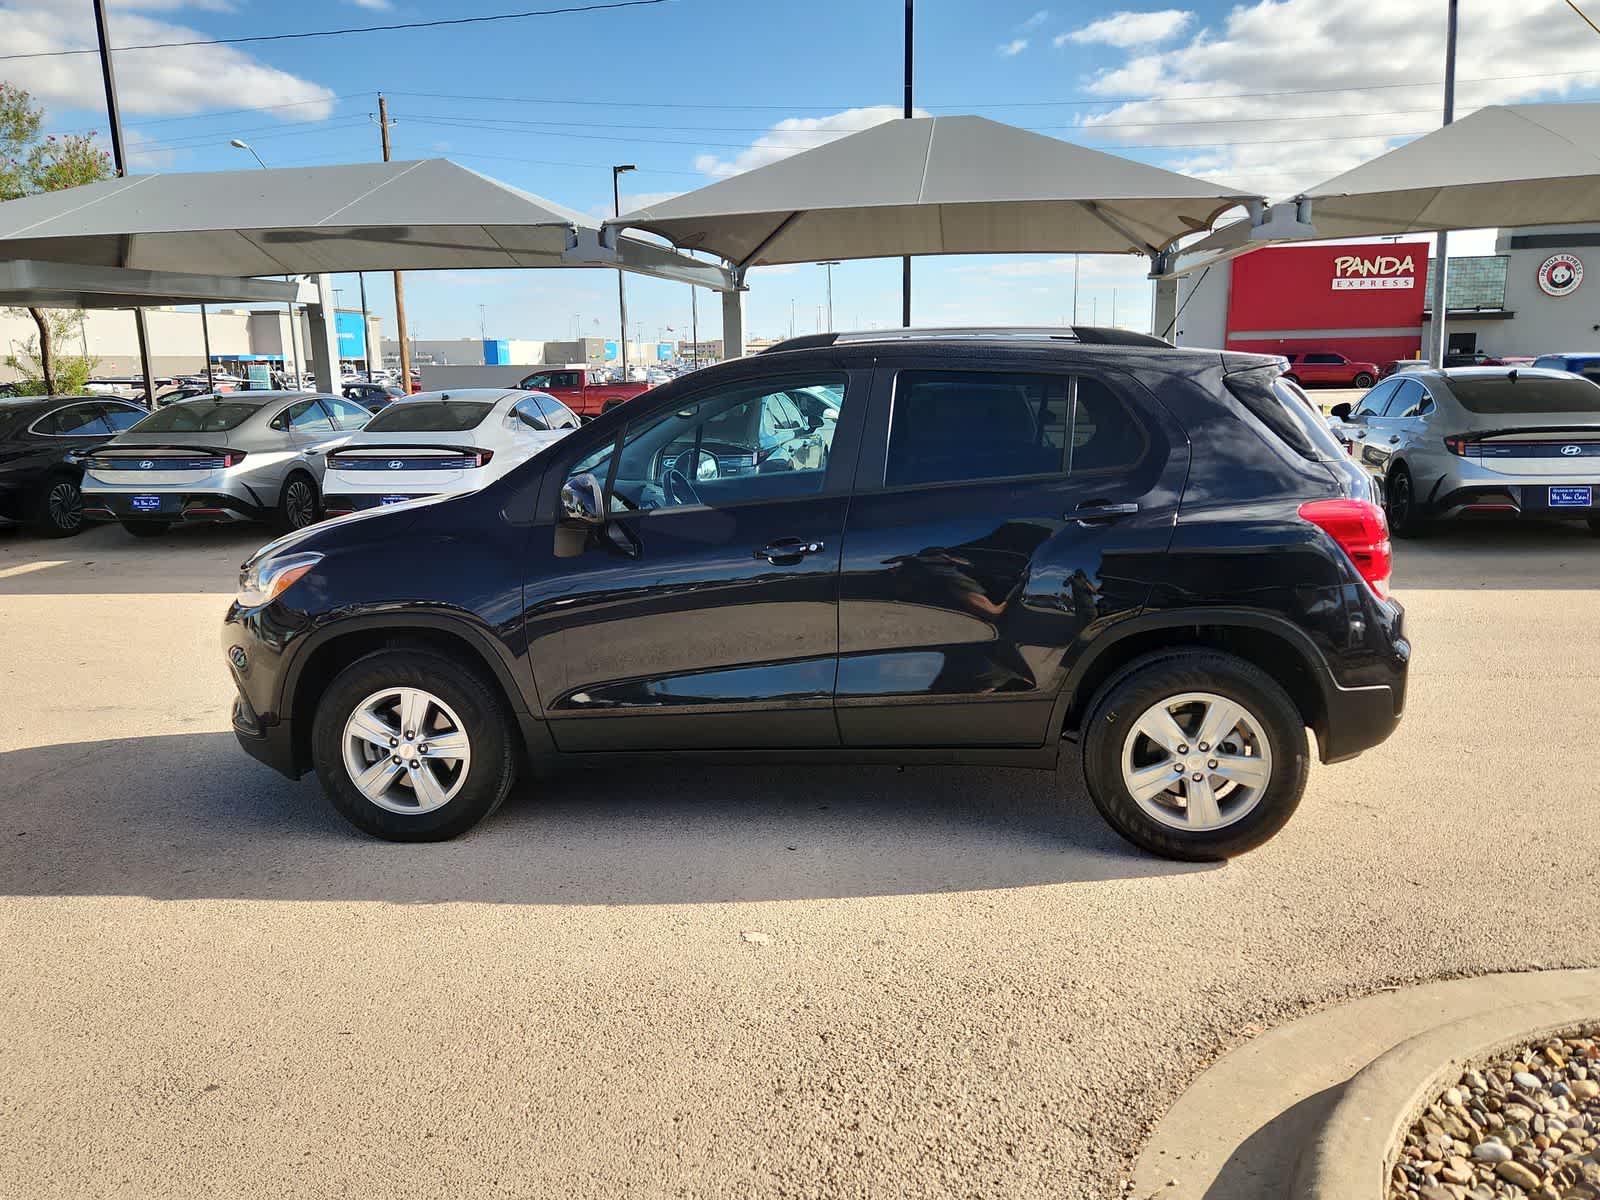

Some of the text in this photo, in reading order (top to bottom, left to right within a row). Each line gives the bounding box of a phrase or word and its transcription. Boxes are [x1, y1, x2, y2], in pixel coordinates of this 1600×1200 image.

[1334, 255, 1414, 277] PANDA
[1540, 255, 1582, 277] PANDA EXPRESS
[1336, 280, 1410, 288] EXPRESS
